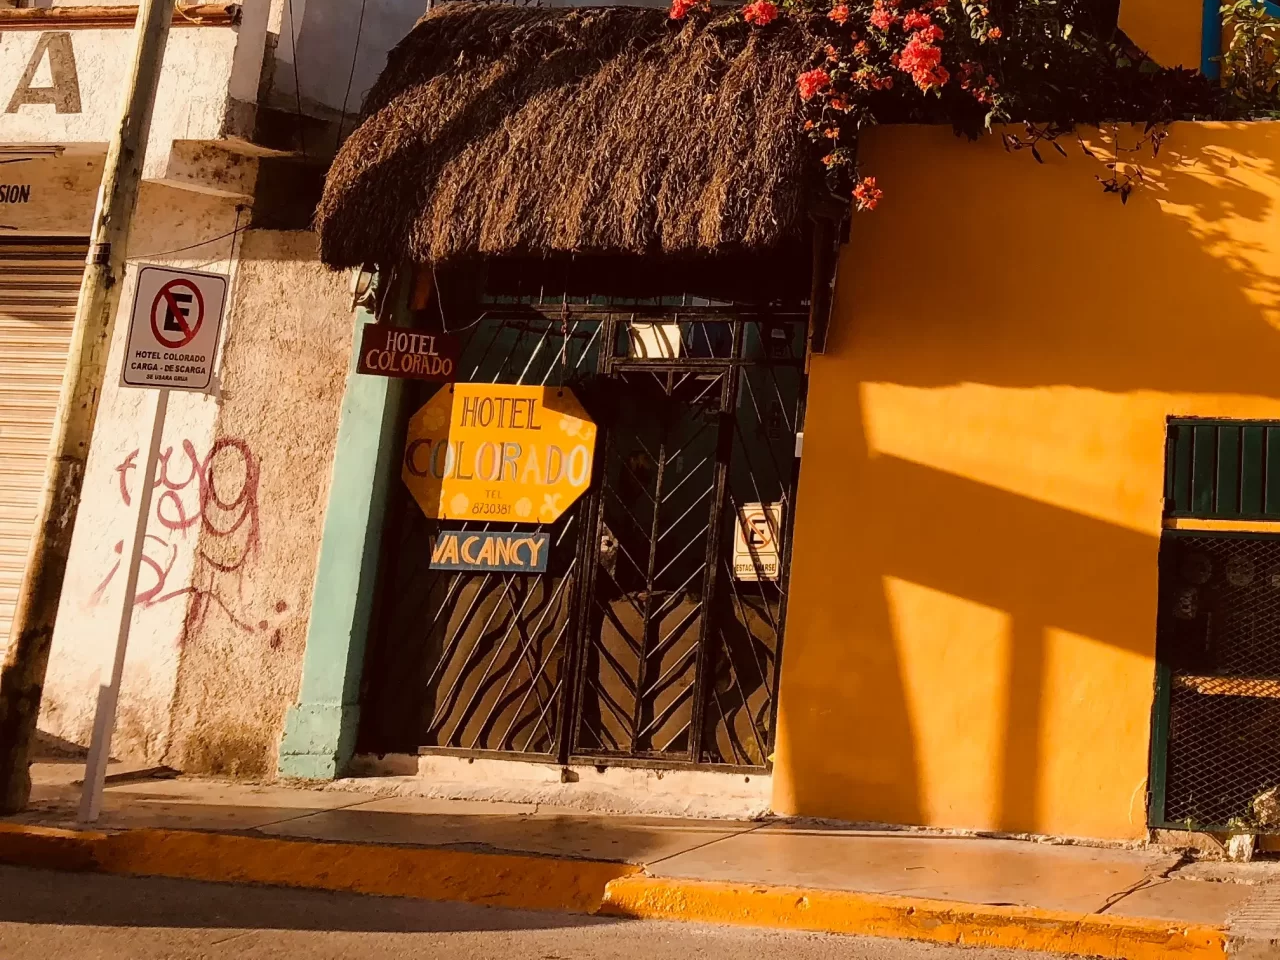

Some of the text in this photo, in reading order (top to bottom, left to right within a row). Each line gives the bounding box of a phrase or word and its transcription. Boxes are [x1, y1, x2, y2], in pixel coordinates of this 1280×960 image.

[4, 31, 82, 114] A
[135, 350, 206, 363] HOTEL COLORADO
[385, 331, 439, 356] HOTEL
[131, 362, 158, 371] CARGA
[365, 348, 453, 376] COLORADO
[460, 396, 542, 430] HOTEL
[406, 438, 590, 488] COLORADO
[485, 489, 503, 499] TEL
[472, 502, 512, 515] 8730381
[430, 535, 545, 567] VACANCY
